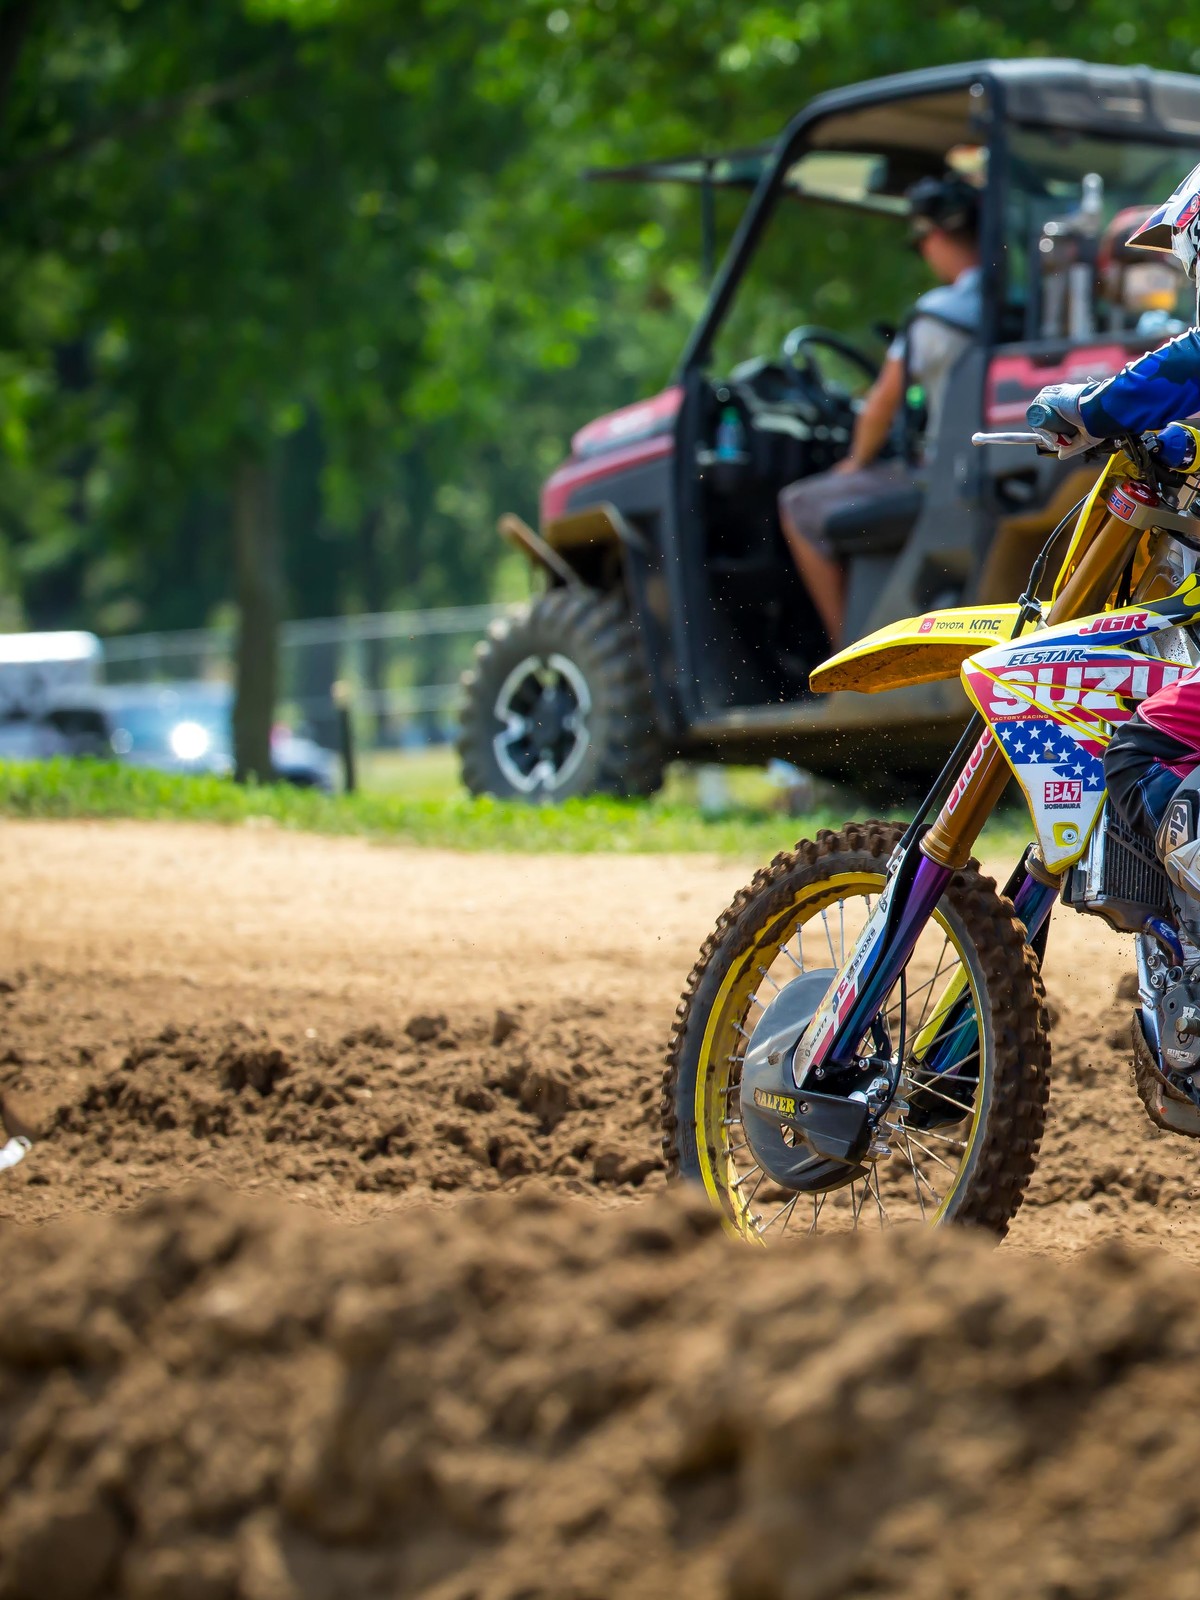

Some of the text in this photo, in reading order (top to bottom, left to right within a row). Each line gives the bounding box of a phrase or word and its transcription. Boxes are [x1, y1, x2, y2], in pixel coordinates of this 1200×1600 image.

[935, 619, 1001, 630] TOYOTA KMC
[1078, 613, 1149, 636] JGR
[1006, 649, 1088, 668] ECSTAR
[989, 666, 1192, 716] SUZU
